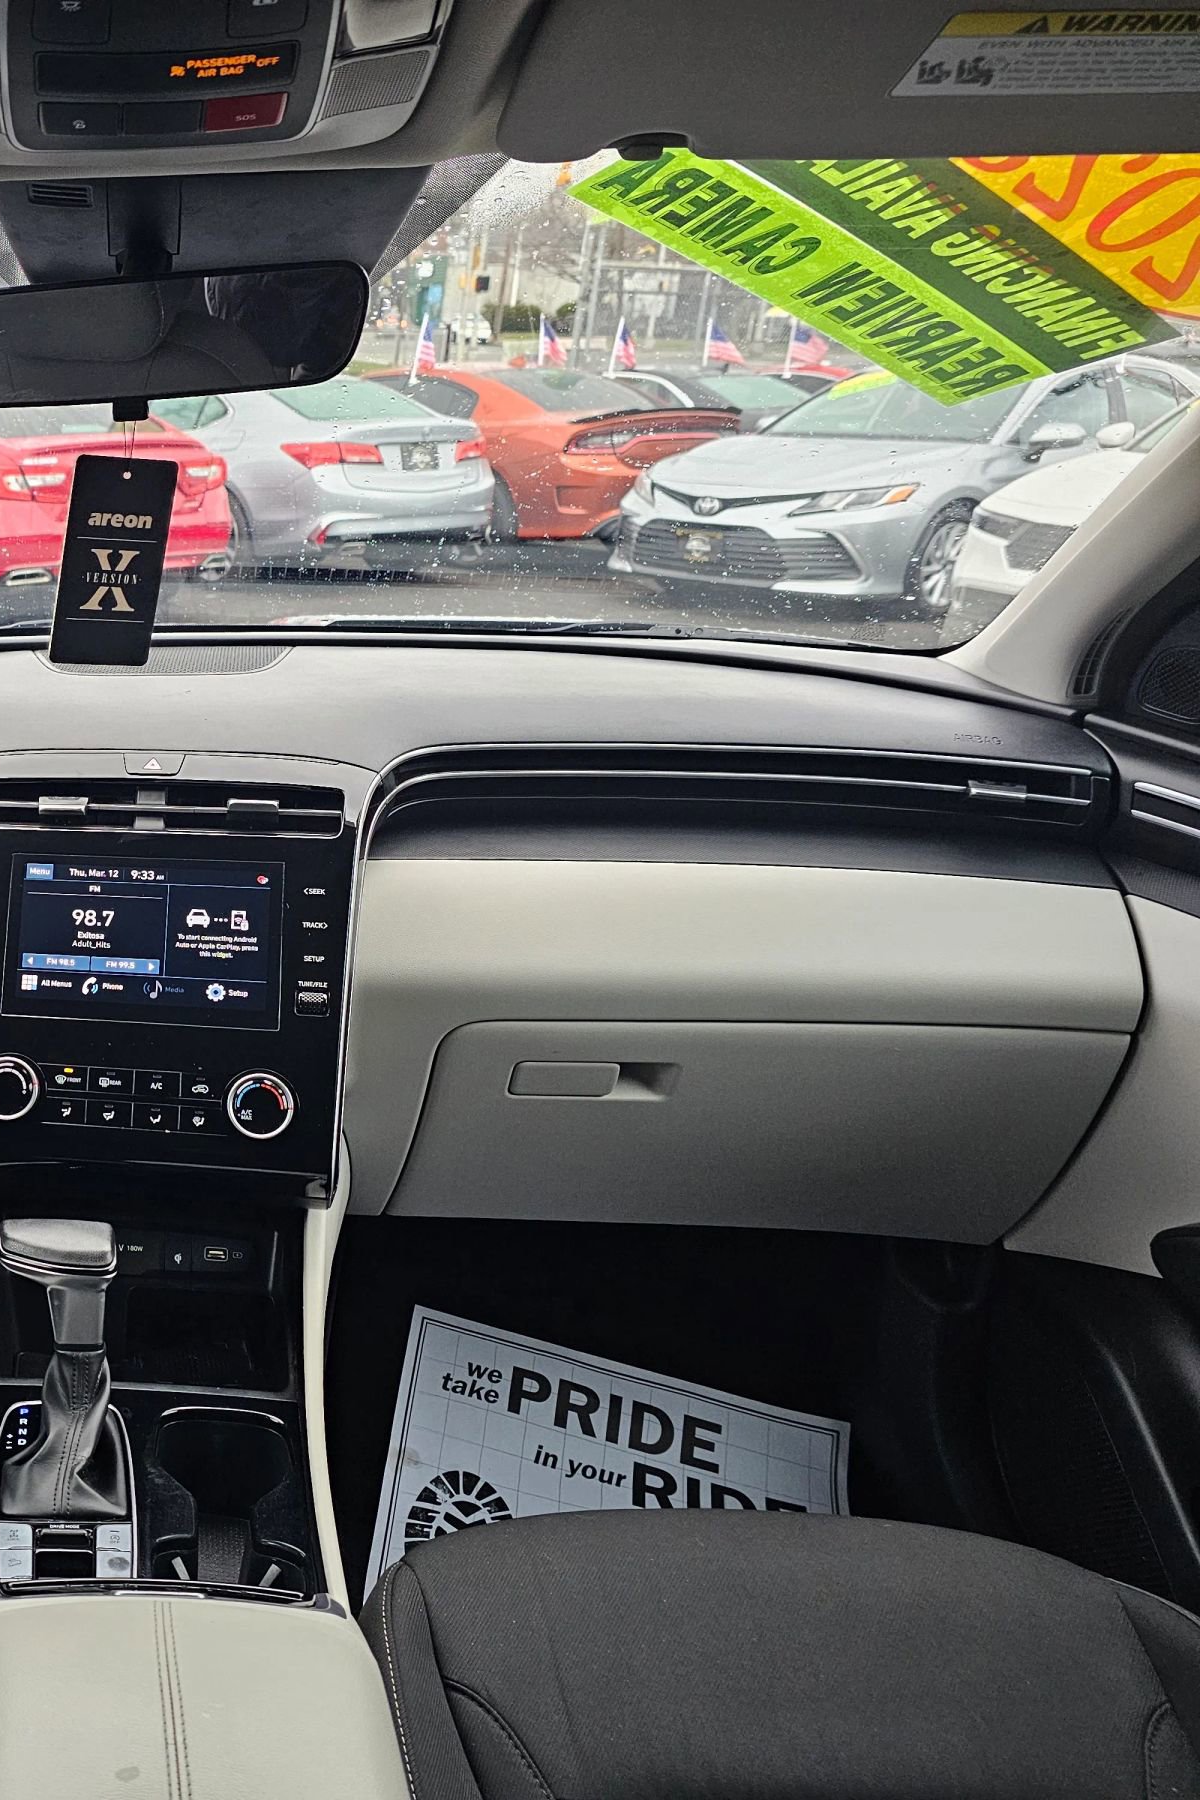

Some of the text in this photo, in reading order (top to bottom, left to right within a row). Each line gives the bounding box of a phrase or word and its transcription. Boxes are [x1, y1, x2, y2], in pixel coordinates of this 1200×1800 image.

[186, 54, 257, 69] PASSENGER
[256, 56, 280, 67] OFF
[196, 66, 244, 78] AIR BAG
[87, 512, 153, 529] areon
[86, 572, 137, 585] VERSION
[953, 733, 1003, 745] AIRBAG
[29, 867, 51, 875] Menu
[69, 868, 87, 878] Thu,
[88, 868, 106, 877] Mar.
[109, 870, 119, 878] 12
[130, 870, 155, 880] 9:33
[72, 909, 114, 927] 98.7
[77, 931, 105, 940] Exitosa
[201, 935, 233, 943] connecting
[119, 961, 135, 969] 99.5
[50, 980, 72, 988] Menus
[165, 985, 184, 993] Media
[298, 980, 328, 988] TUNE/FILE
[228, 989, 248, 999] Setup
[150, 1082, 163, 1090] A/C
[466, 1360, 503, 1384] we
[441, 1365, 723, 1474] take PRIDE
[533, 1445, 558, 1469] in
[564, 1459, 627, 1488] your
